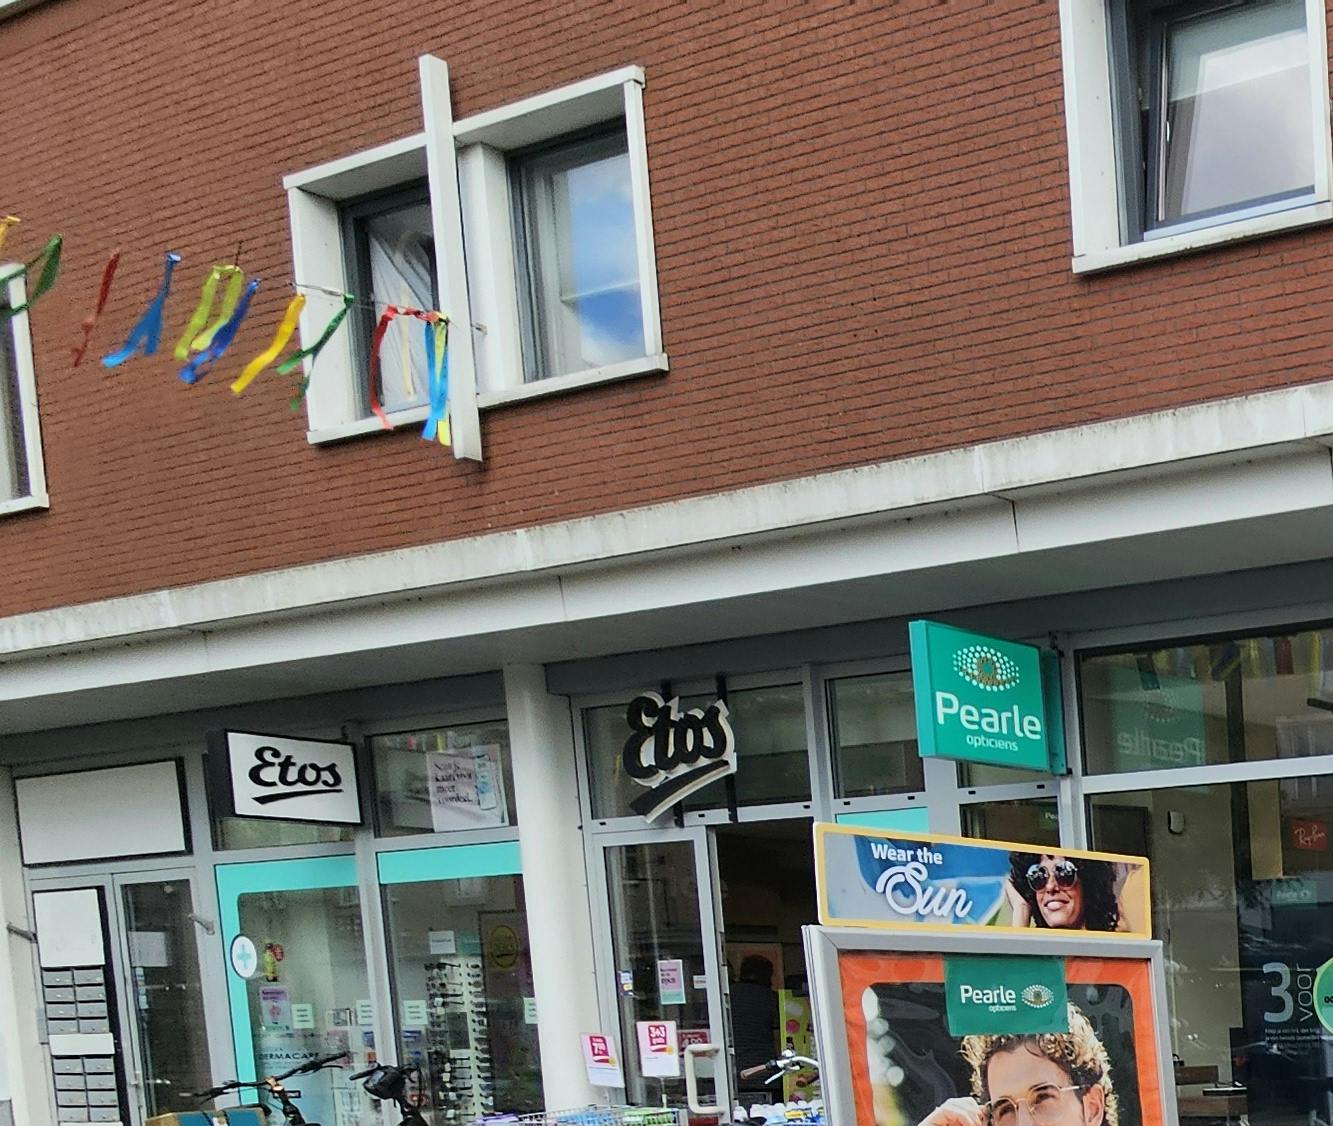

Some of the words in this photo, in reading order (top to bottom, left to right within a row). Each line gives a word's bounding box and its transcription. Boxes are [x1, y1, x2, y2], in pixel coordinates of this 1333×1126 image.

[935, 690, 1042, 740] Pearle
[622, 691, 735, 788] Etos
[966, 734, 1019, 751] opticiens
[247, 746, 343, 788] Etos
[870, 842, 915, 863] Wear
[917, 846, 943, 865] the
[875, 860, 973, 918] Sun
[959, 984, 1017, 1004] Pearle
[1262, 961, 1294, 1023] 3
[1296, 962, 1314, 1022] voor
